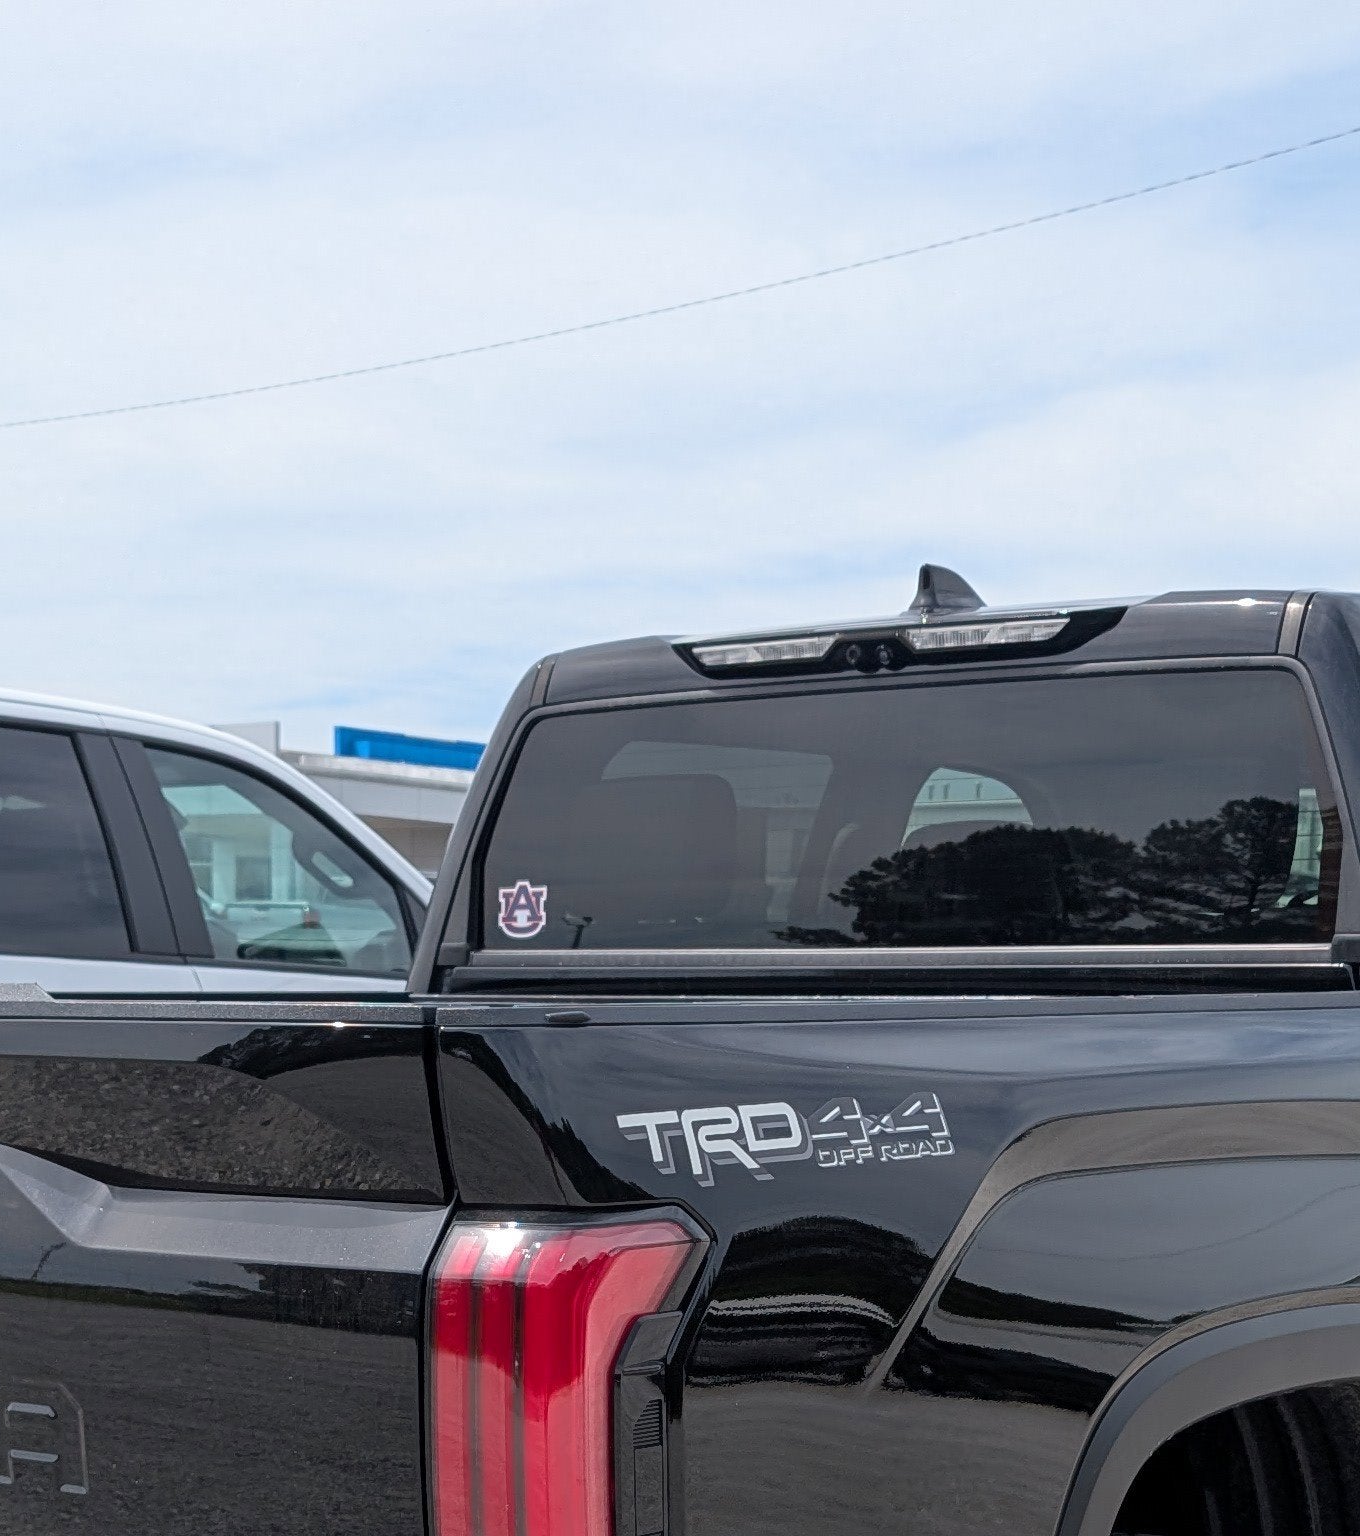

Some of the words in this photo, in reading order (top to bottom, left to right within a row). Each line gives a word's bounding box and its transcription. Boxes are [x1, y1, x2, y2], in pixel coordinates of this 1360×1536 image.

[615, 1101, 812, 1188] TRD
[817, 1146, 874, 1168] OFF
[879, 1138, 956, 1164] ROAD
